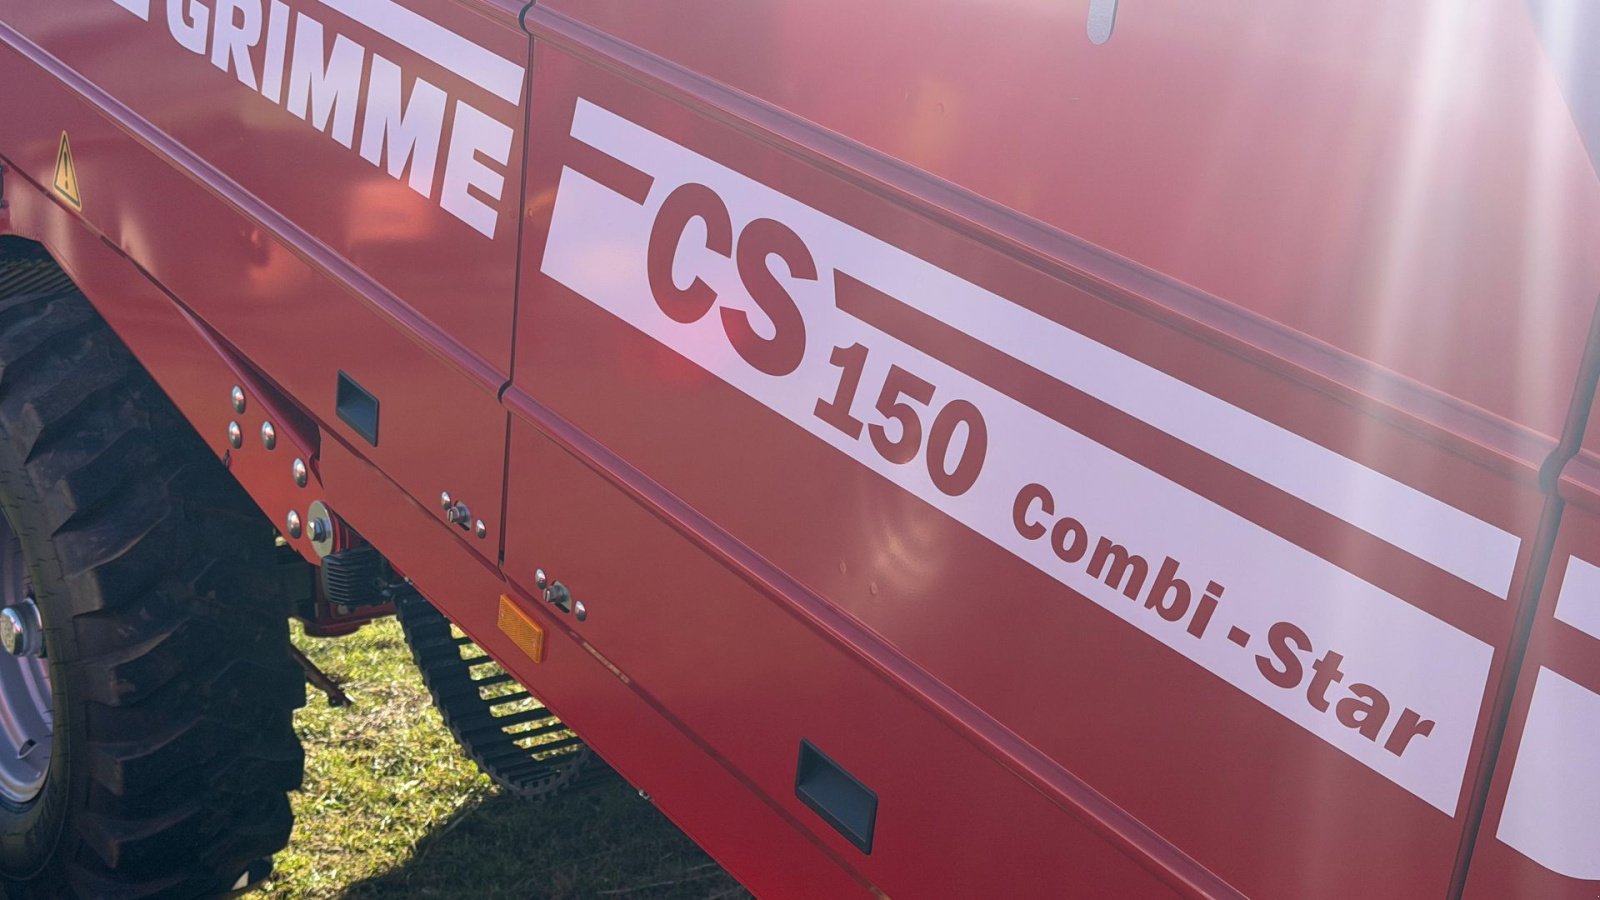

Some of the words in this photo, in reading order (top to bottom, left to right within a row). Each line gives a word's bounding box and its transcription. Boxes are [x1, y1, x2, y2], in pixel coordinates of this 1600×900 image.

[167, 0, 514, 240] GRIMME
[647, 182, 818, 377] CS
[813, 342, 988, 497] 150
